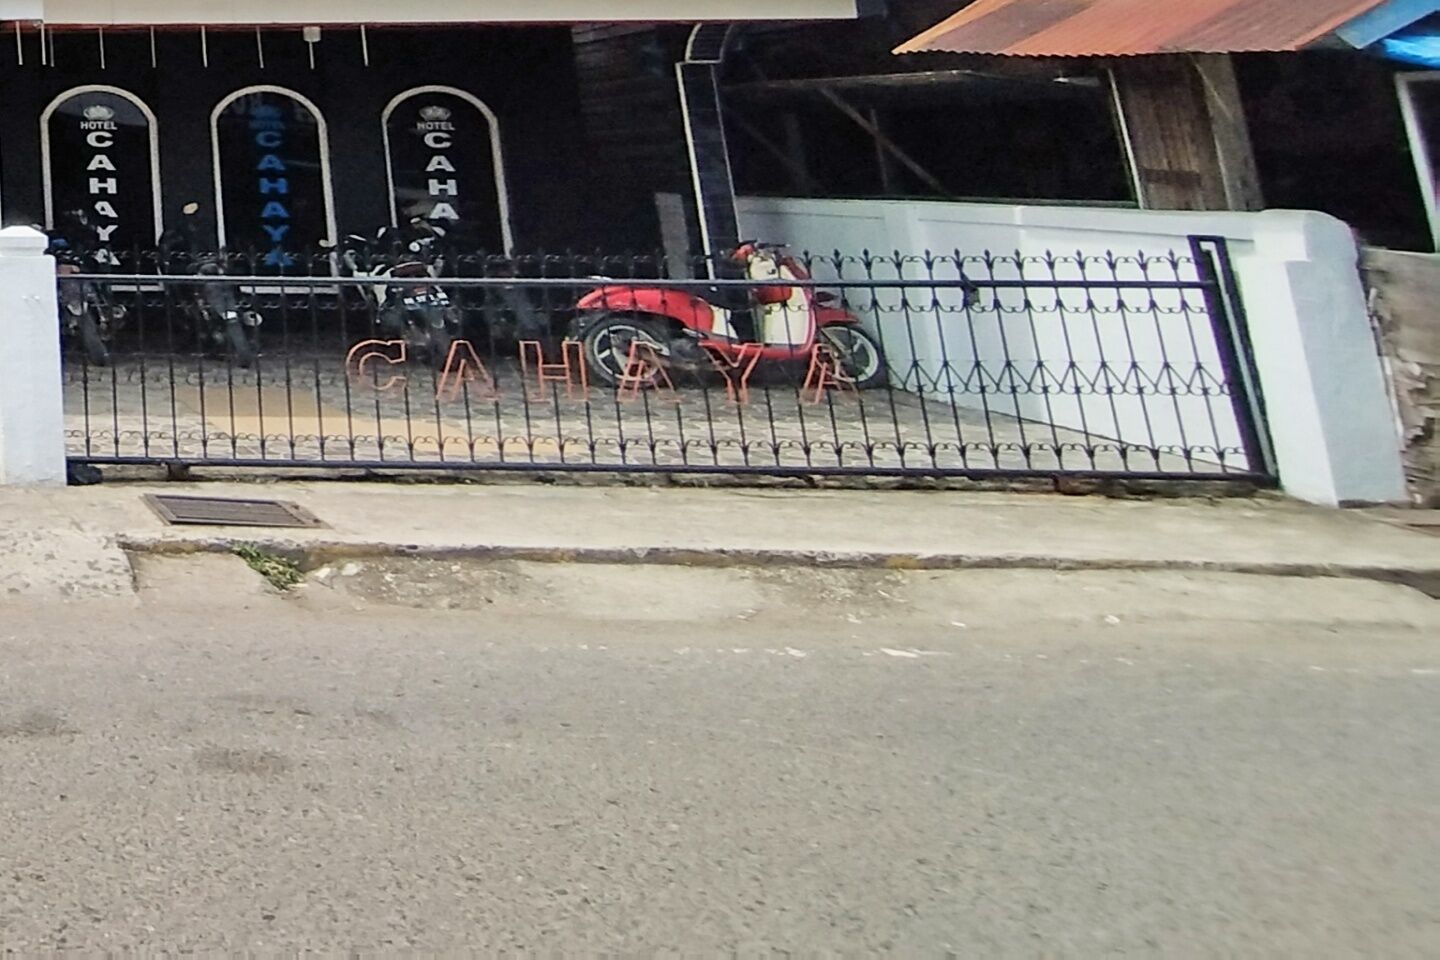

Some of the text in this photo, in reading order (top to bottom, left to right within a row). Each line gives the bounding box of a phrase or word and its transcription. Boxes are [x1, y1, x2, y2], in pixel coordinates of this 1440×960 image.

[80, 121, 117, 130] HOTEL
[417, 121, 455, 131] HOTEL
[424, 132, 460, 237] CAHA
[346, 340, 858, 404] CAHAYA
